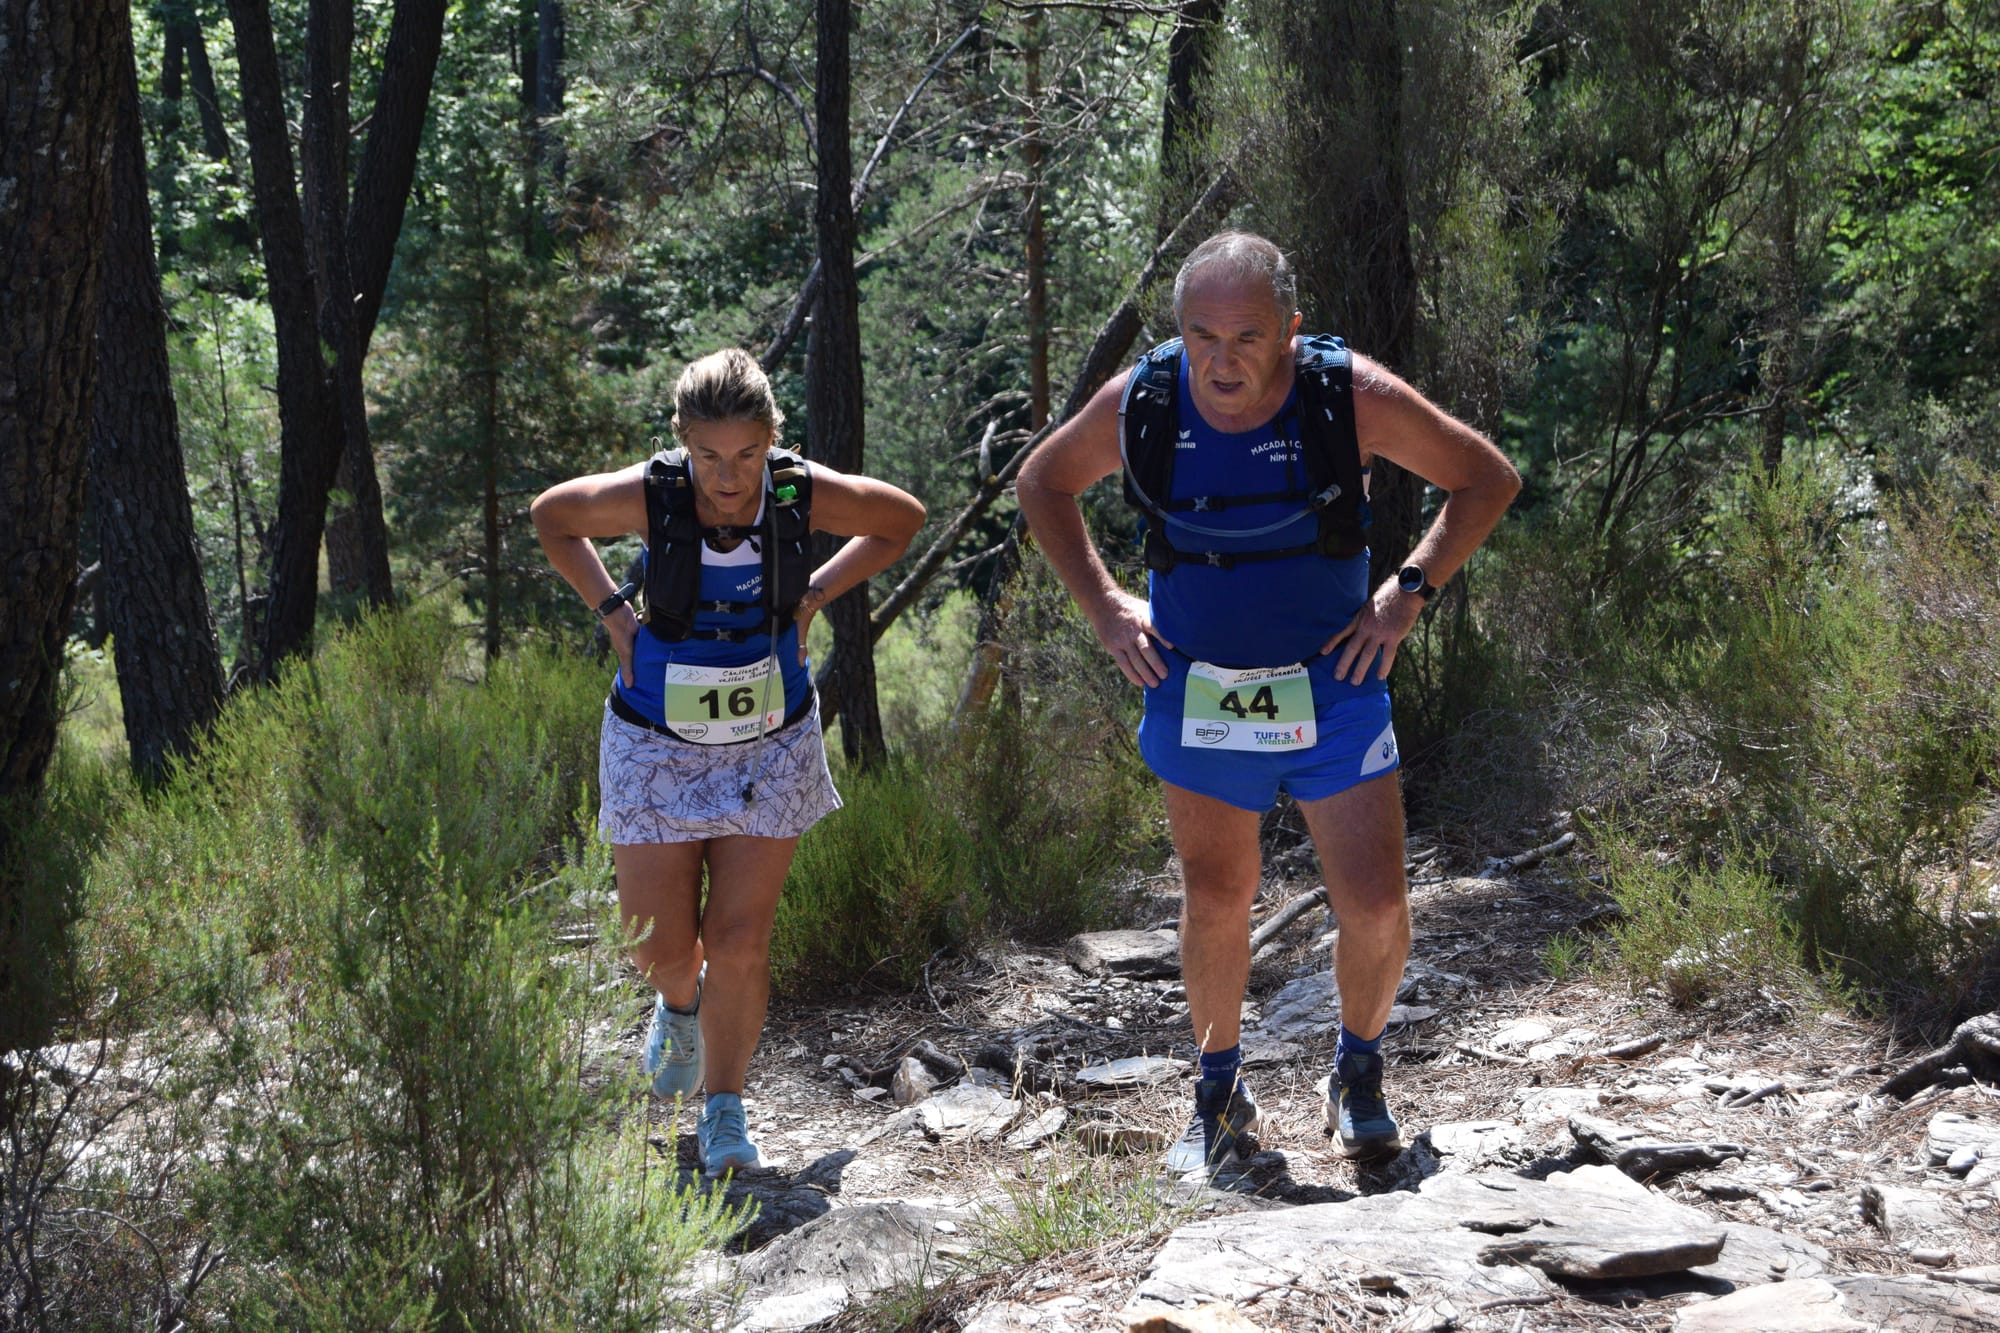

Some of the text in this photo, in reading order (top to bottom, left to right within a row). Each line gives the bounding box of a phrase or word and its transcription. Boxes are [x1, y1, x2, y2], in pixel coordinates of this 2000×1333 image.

[699, 687, 755, 719] 16
[1220, 685, 1279, 720] 44
[1195, 728, 1225, 738] BFP
[1253, 731, 1291, 740] TUFF'S
[1256, 737, 1296, 745] Aventure
